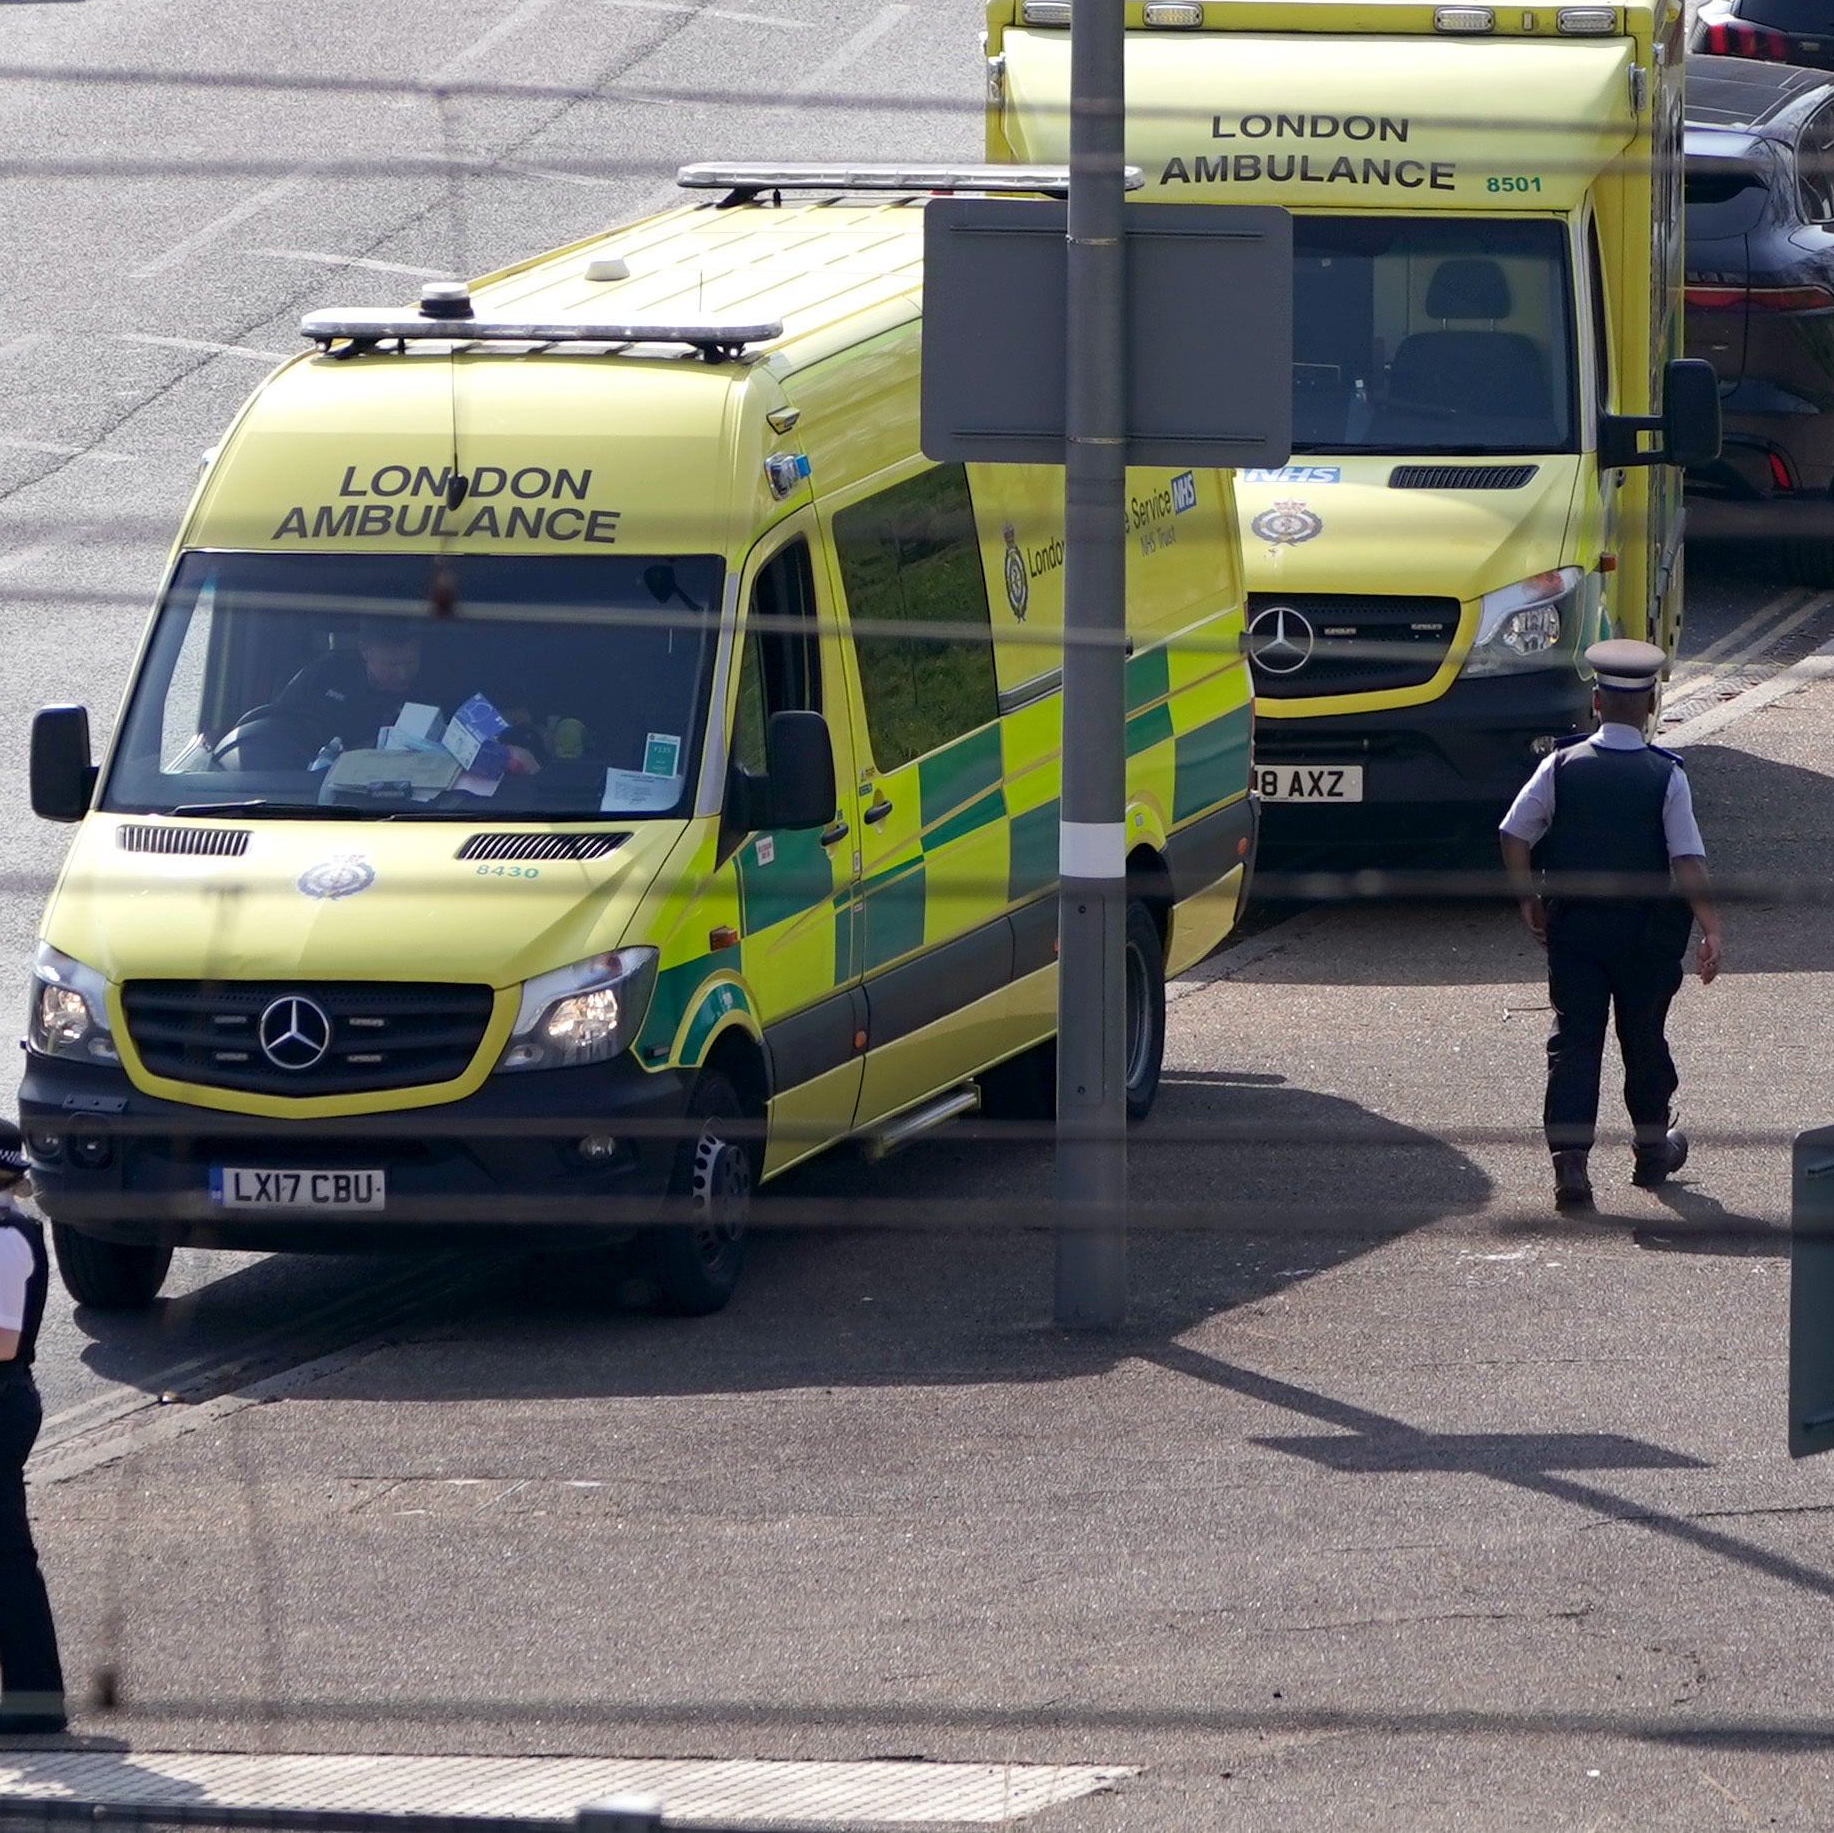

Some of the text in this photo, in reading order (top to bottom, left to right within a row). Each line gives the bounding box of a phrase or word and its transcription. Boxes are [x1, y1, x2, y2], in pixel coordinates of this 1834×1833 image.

[1211, 113, 1410, 143] LONDON
[1159, 154, 1543, 194] AMBULANCE 8501
[339, 464, 593, 501] LONDON
[1253, 467, 1337, 483] NHS
[1131, 473, 1197, 531] Service NHS
[271, 504, 621, 544] AMBULANCE
[1140, 527, 1177, 558] NHS Trust
[1288, 770, 1344, 797] AXZ
[475, 861, 540, 880] 8430
[233, 1172, 372, 1204] LX17 CBU
